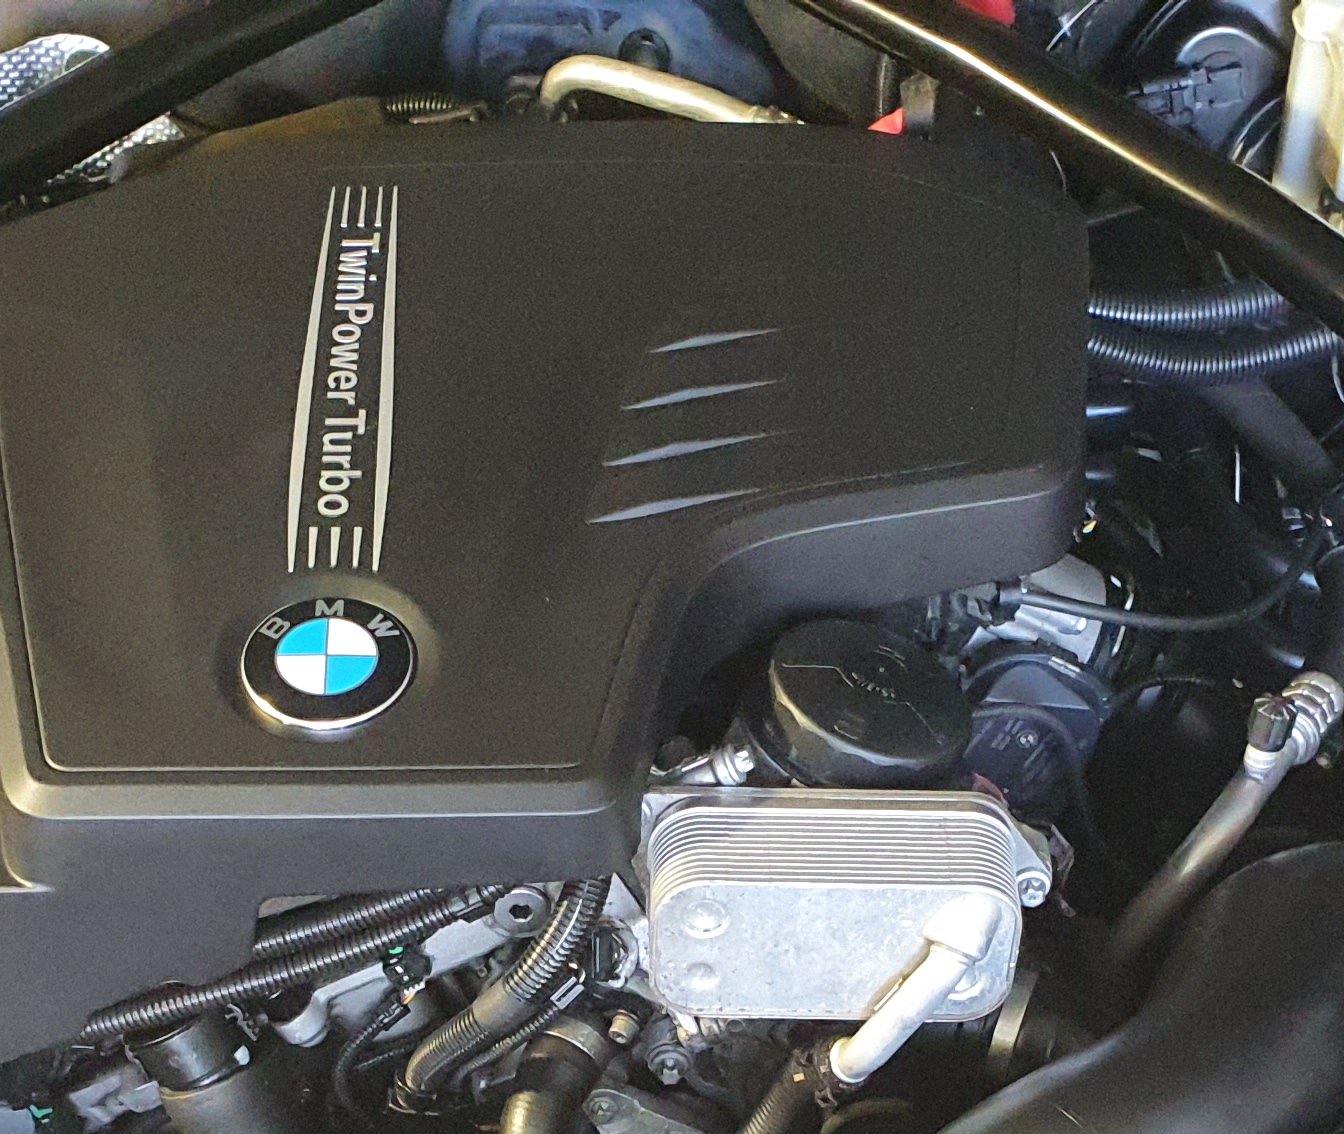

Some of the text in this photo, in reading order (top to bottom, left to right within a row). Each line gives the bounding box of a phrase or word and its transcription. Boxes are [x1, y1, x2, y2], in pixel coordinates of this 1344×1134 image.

[317, 232, 380, 518] TwinPower Turbo
[258, 599, 400, 640] BMW
